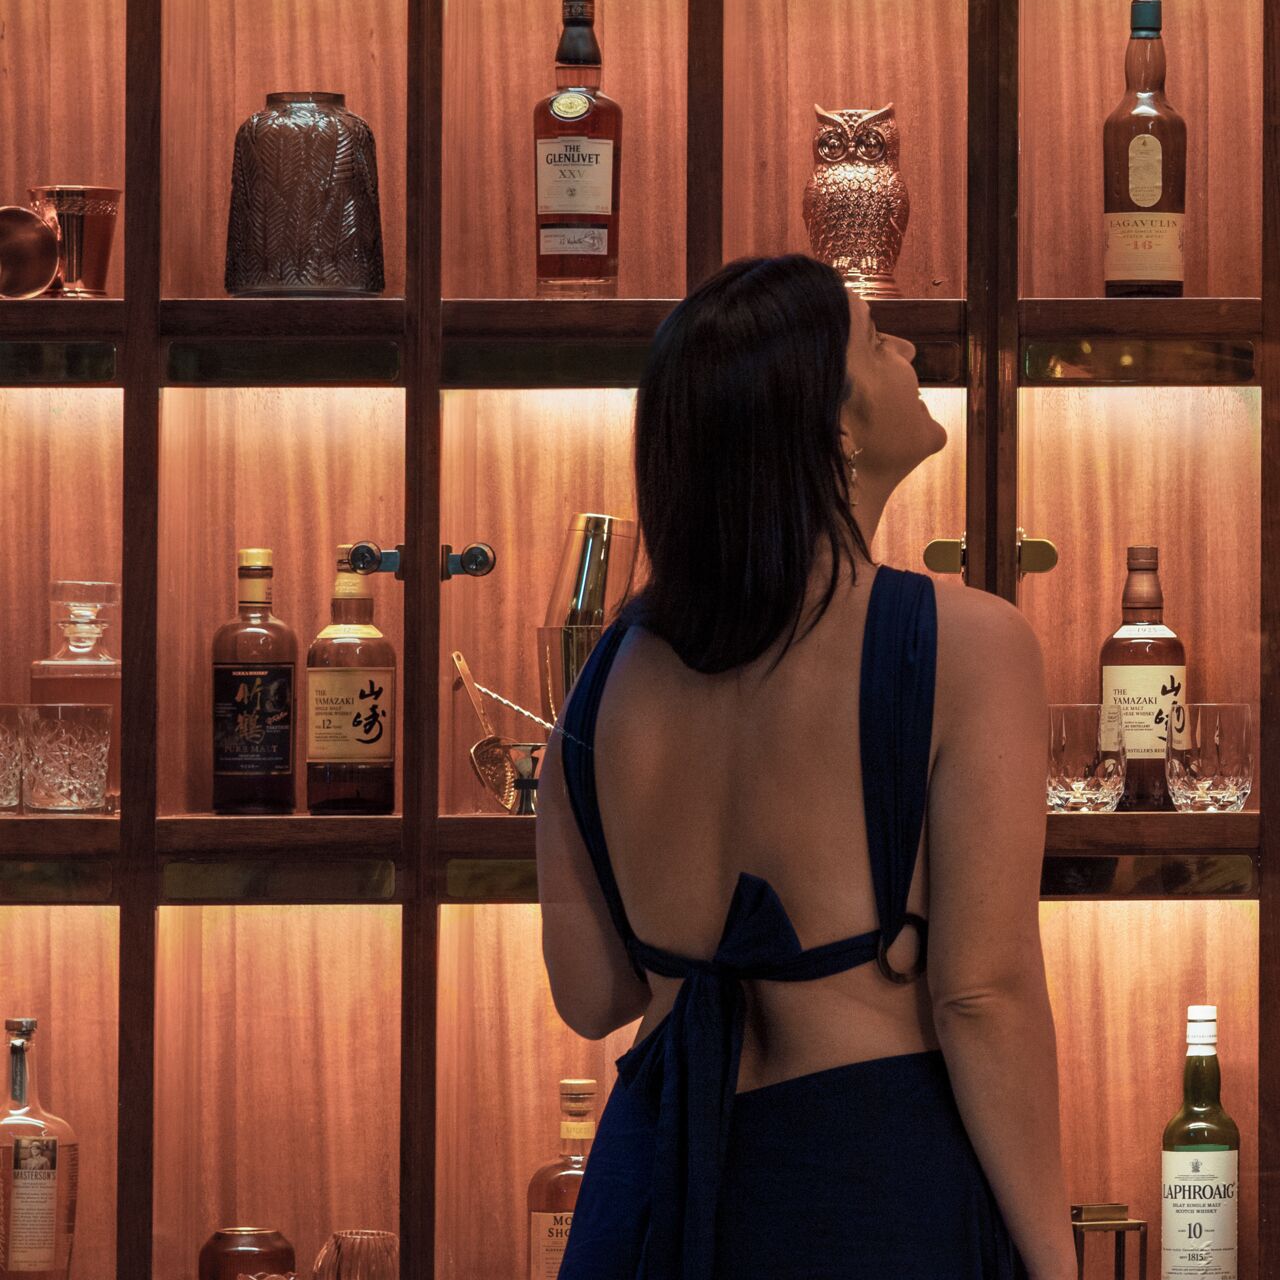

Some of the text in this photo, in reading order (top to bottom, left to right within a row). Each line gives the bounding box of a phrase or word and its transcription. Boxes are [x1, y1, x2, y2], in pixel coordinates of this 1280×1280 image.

[564, 144, 581, 153] THE
[545, 153, 601, 165] GLENLIVET
[558, 169, 585, 179] XXV
[1109, 219, 1177, 228] LAGAVULIN
[315, 689, 327, 697] THE
[1113, 688, 1128, 696] THE
[315, 697, 355, 706] YAMAZAKI
[1113, 696, 1158, 705] YAMAZAKI
[322, 719, 332, 729] 12
[224, 744, 249, 753] PURE
[13, 1170, 57, 1181] MASTERSON'S
[1163, 1183, 1234, 1200] LAPHROAIG
[1187, 1222, 1203, 1239] 10
